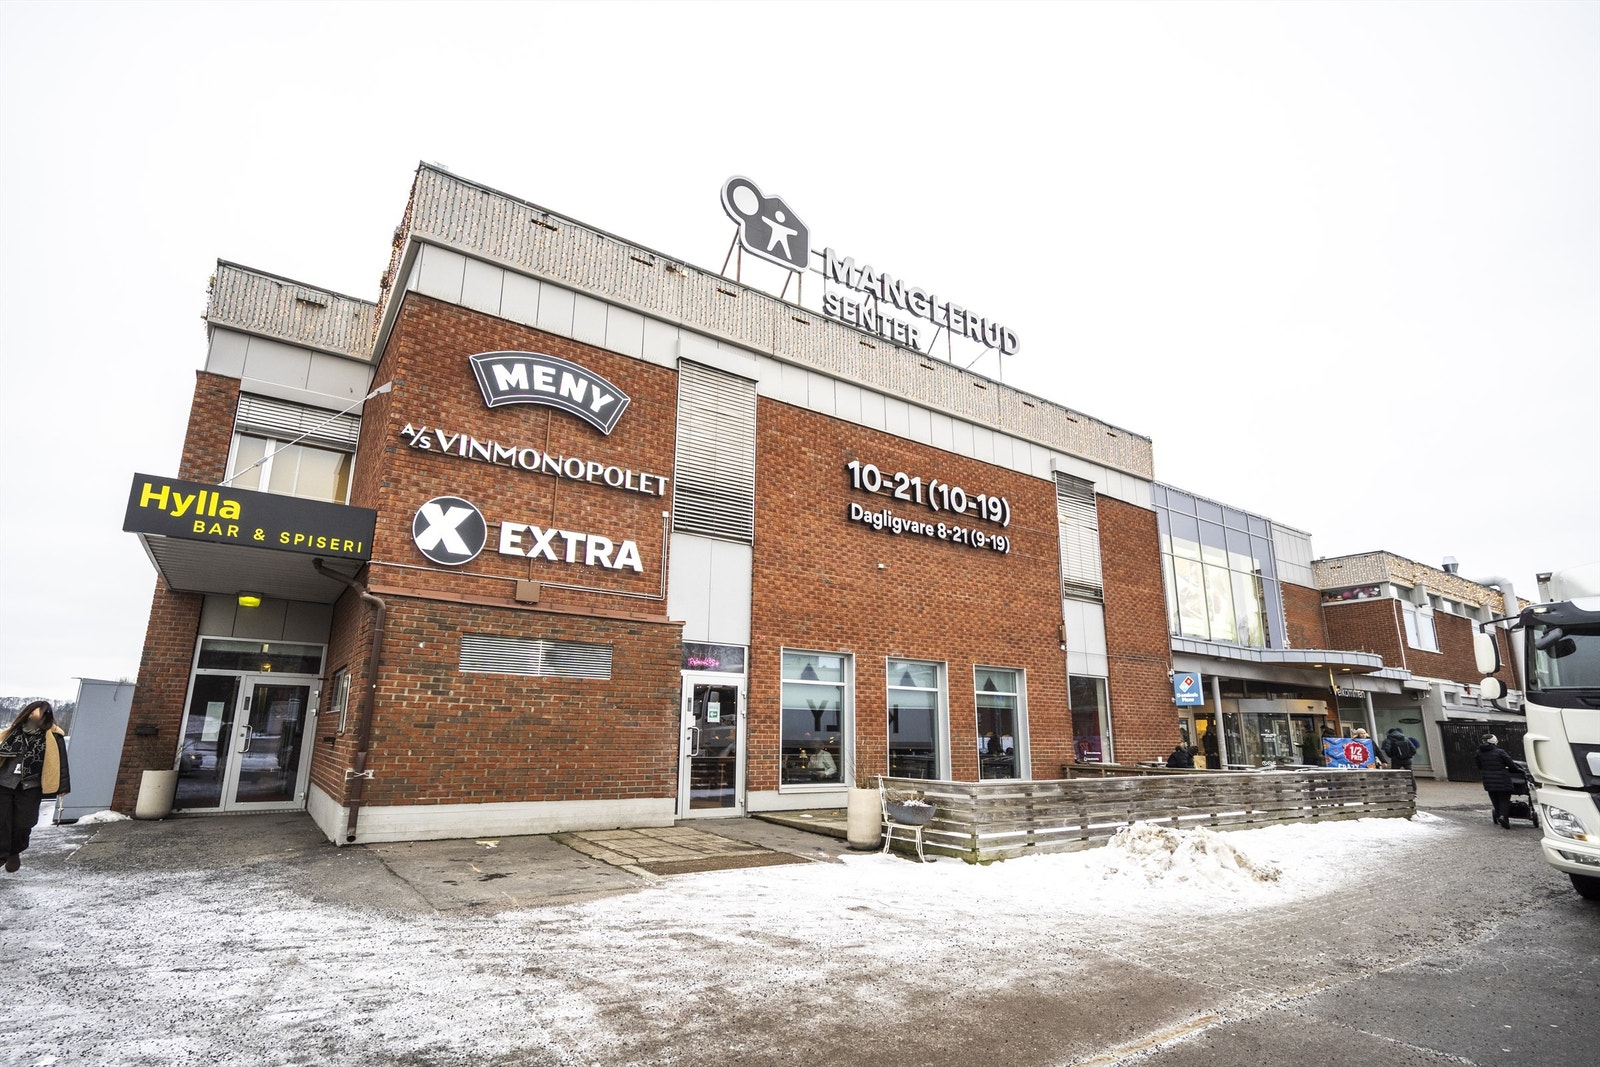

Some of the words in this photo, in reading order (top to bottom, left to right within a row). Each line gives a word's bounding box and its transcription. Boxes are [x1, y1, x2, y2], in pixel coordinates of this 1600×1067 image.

[823, 246, 1020, 356] MANGLERUD
[823, 290, 922, 350] SENTER
[491, 364, 616, 415] MENY
[433, 428, 670, 497] VINMONOPOLET
[139, 482, 241, 520] Hylla
[846, 460, 922, 504] 10-21
[928, 479, 1011, 527] (10-19)
[193, 521, 240, 538] BAR
[254, 528, 266, 541] &
[280, 531, 363, 554] SPISERI
[498, 521, 644, 573] EXTRA
[849, 502, 935, 535] Dagligvare
[937, 522, 969, 545] 8-21
[970, 529, 1011, 555] (9-19)
[1349, 746, 1363, 755] 1/2
